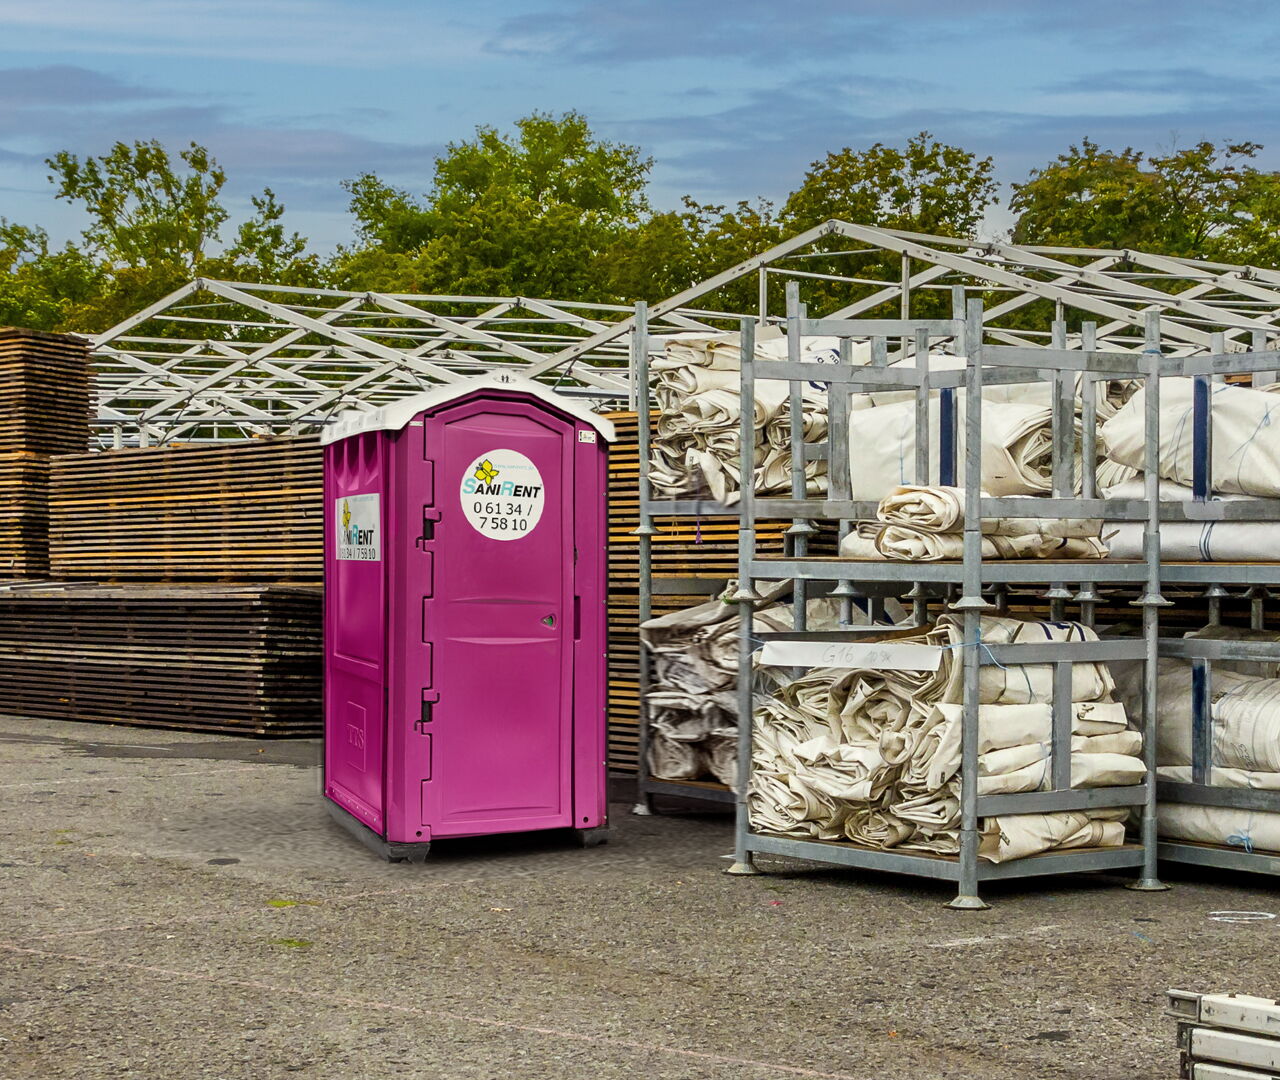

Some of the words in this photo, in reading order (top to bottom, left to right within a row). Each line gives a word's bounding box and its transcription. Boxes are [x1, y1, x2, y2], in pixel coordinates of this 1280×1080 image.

[473, 502, 482, 514] 0
[485, 502, 501, 515] 61
[506, 503, 522, 515] 34
[479, 517, 488, 529] 7
[491, 518, 508, 530] 58
[512, 519, 528, 531] 10
